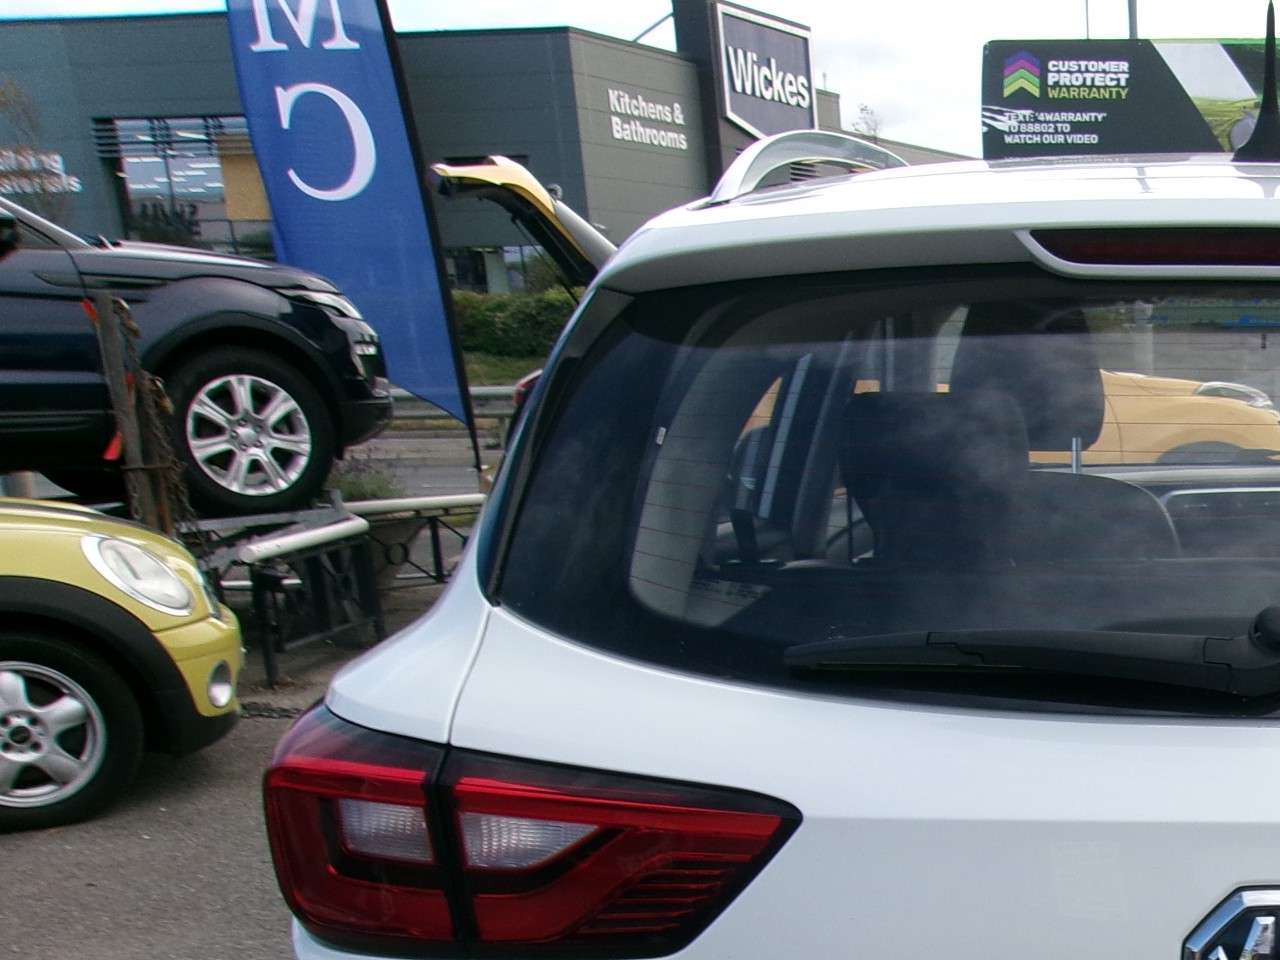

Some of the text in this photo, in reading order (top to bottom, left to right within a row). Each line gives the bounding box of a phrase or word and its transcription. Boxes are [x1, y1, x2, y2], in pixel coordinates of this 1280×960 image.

[1047, 61, 1130, 72] CUSTOMER
[728, 46, 810, 109] Wickes
[1047, 73, 1130, 86] PROTECT
[1047, 87, 1129, 99] WARRANTY
[607, 88, 685, 125] Kitchens &
[610, 115, 688, 150] Bathrooms
[1056, 123, 1071, 133] TO
[1004, 134, 1099, 144] WATCH OUR VIDEO
